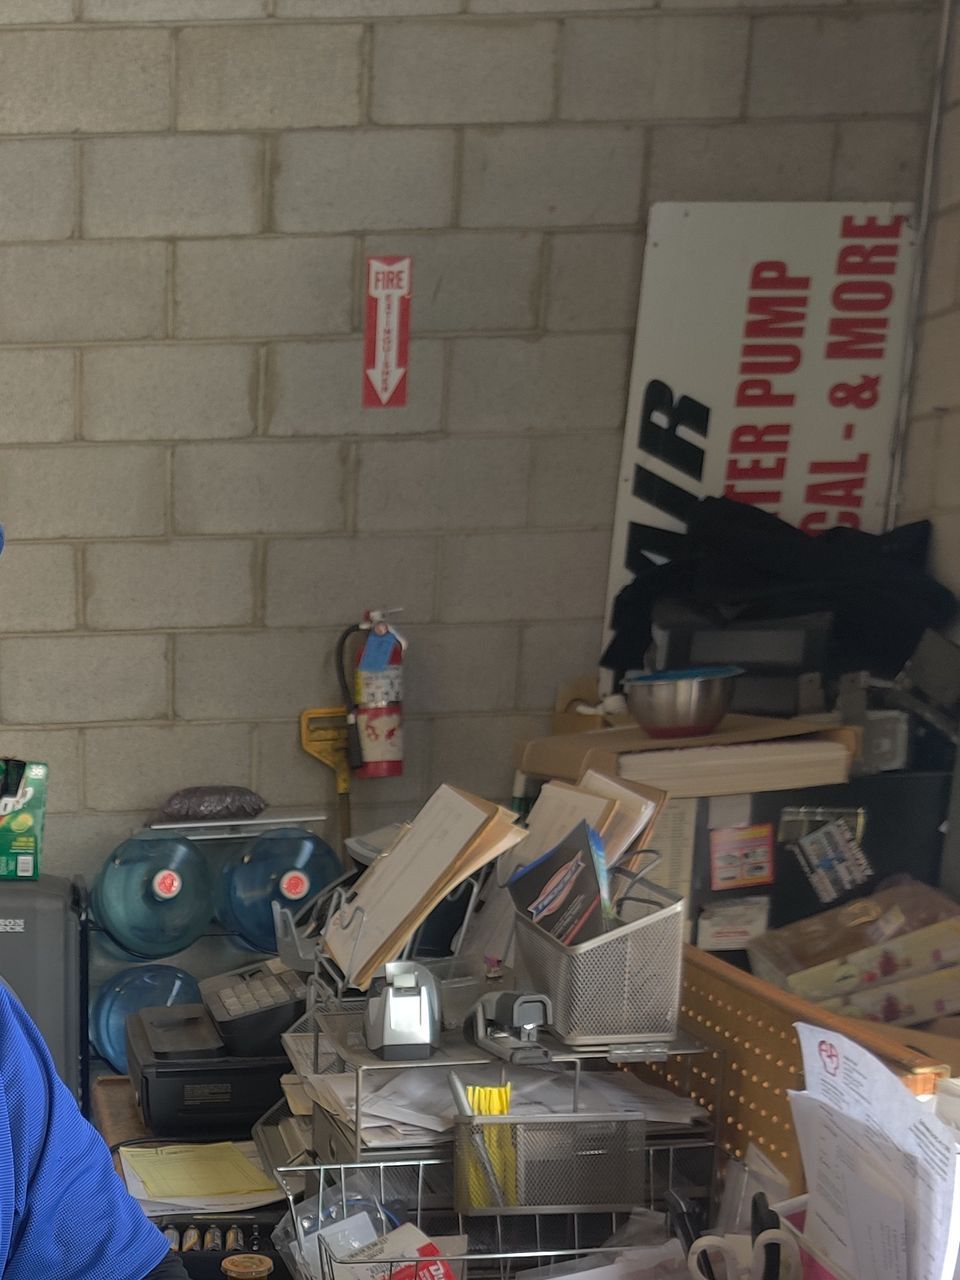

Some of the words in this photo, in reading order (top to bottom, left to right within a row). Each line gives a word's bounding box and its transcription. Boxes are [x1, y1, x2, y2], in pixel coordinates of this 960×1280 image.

[374, 270, 406, 290] FIRE
[825, 214, 908, 360] MORE
[735, 260, 812, 407] PUMP
[827, 374, 881, 410] &
[724, 424, 791, 519] TER
